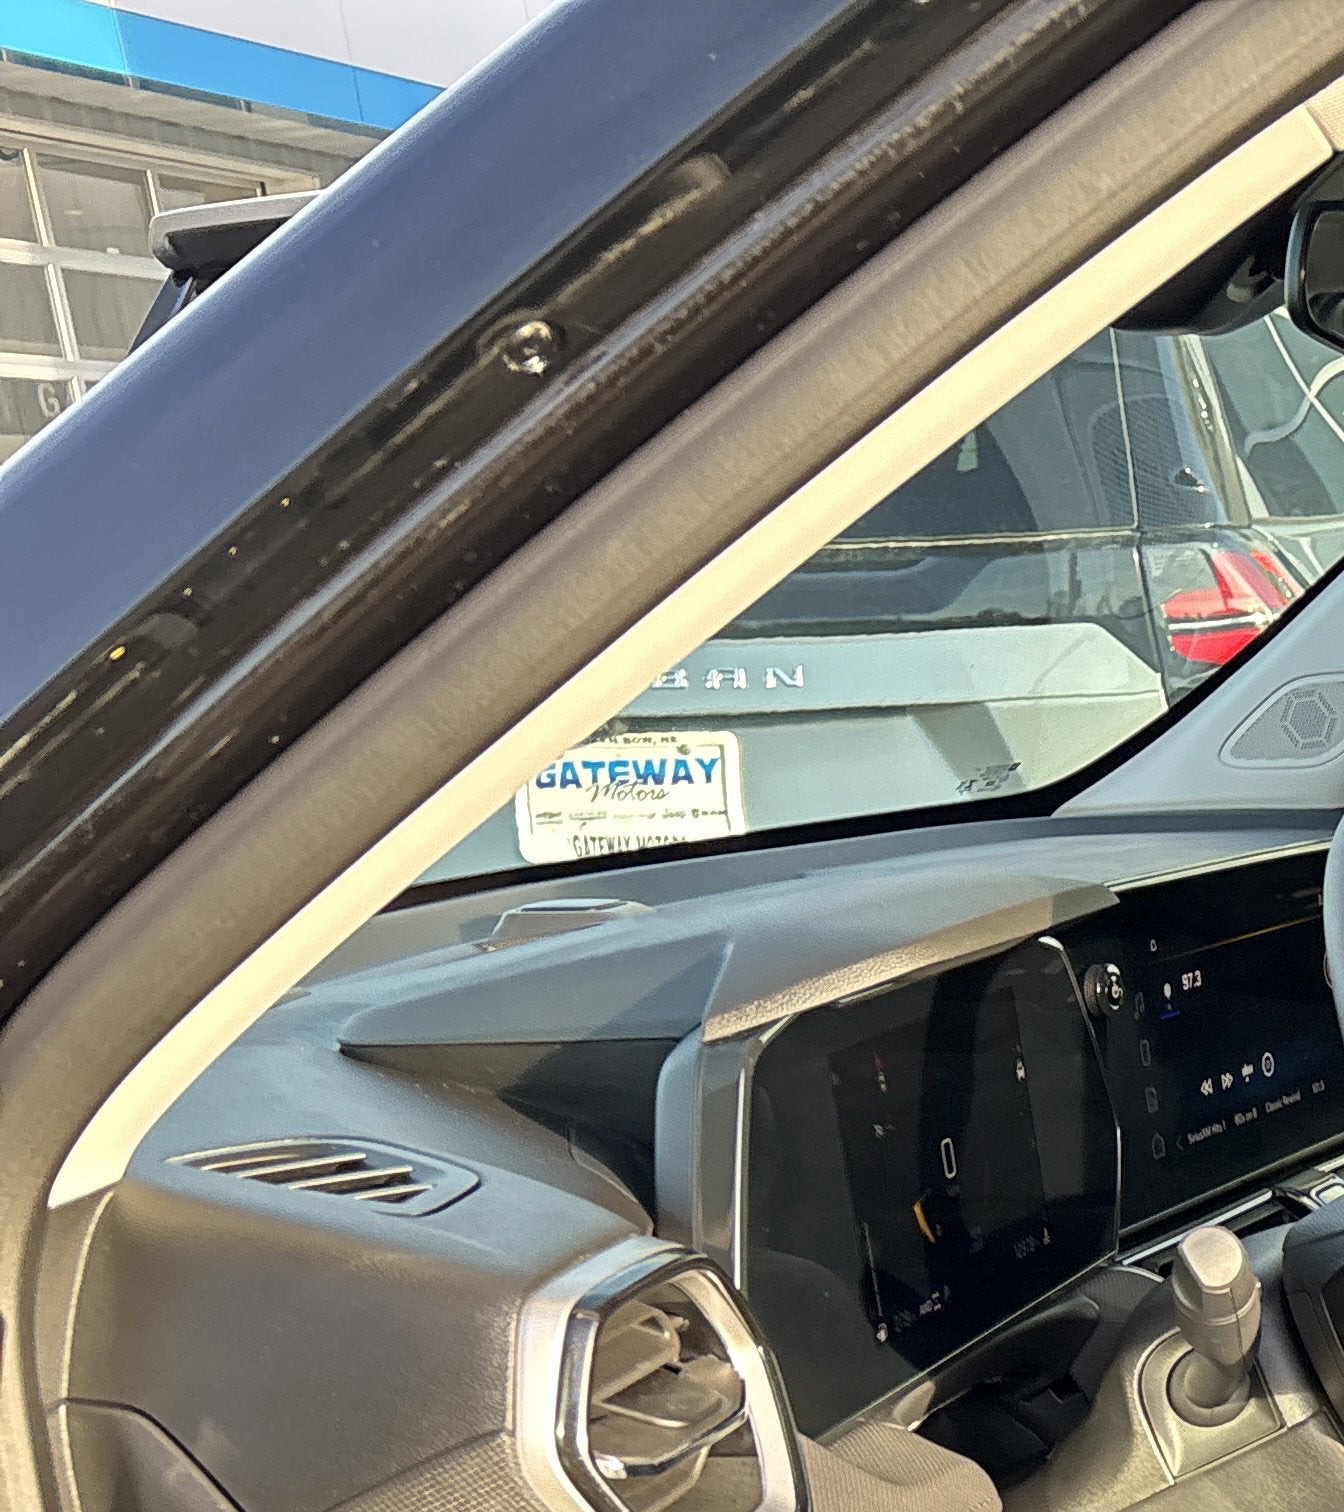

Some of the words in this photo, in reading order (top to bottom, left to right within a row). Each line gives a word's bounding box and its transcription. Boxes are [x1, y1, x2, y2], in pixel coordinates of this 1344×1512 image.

[535, 757, 721, 789] GATEWAY
[585, 779, 670, 803] Motors
[1181, 969, 1202, 990] 97.3
